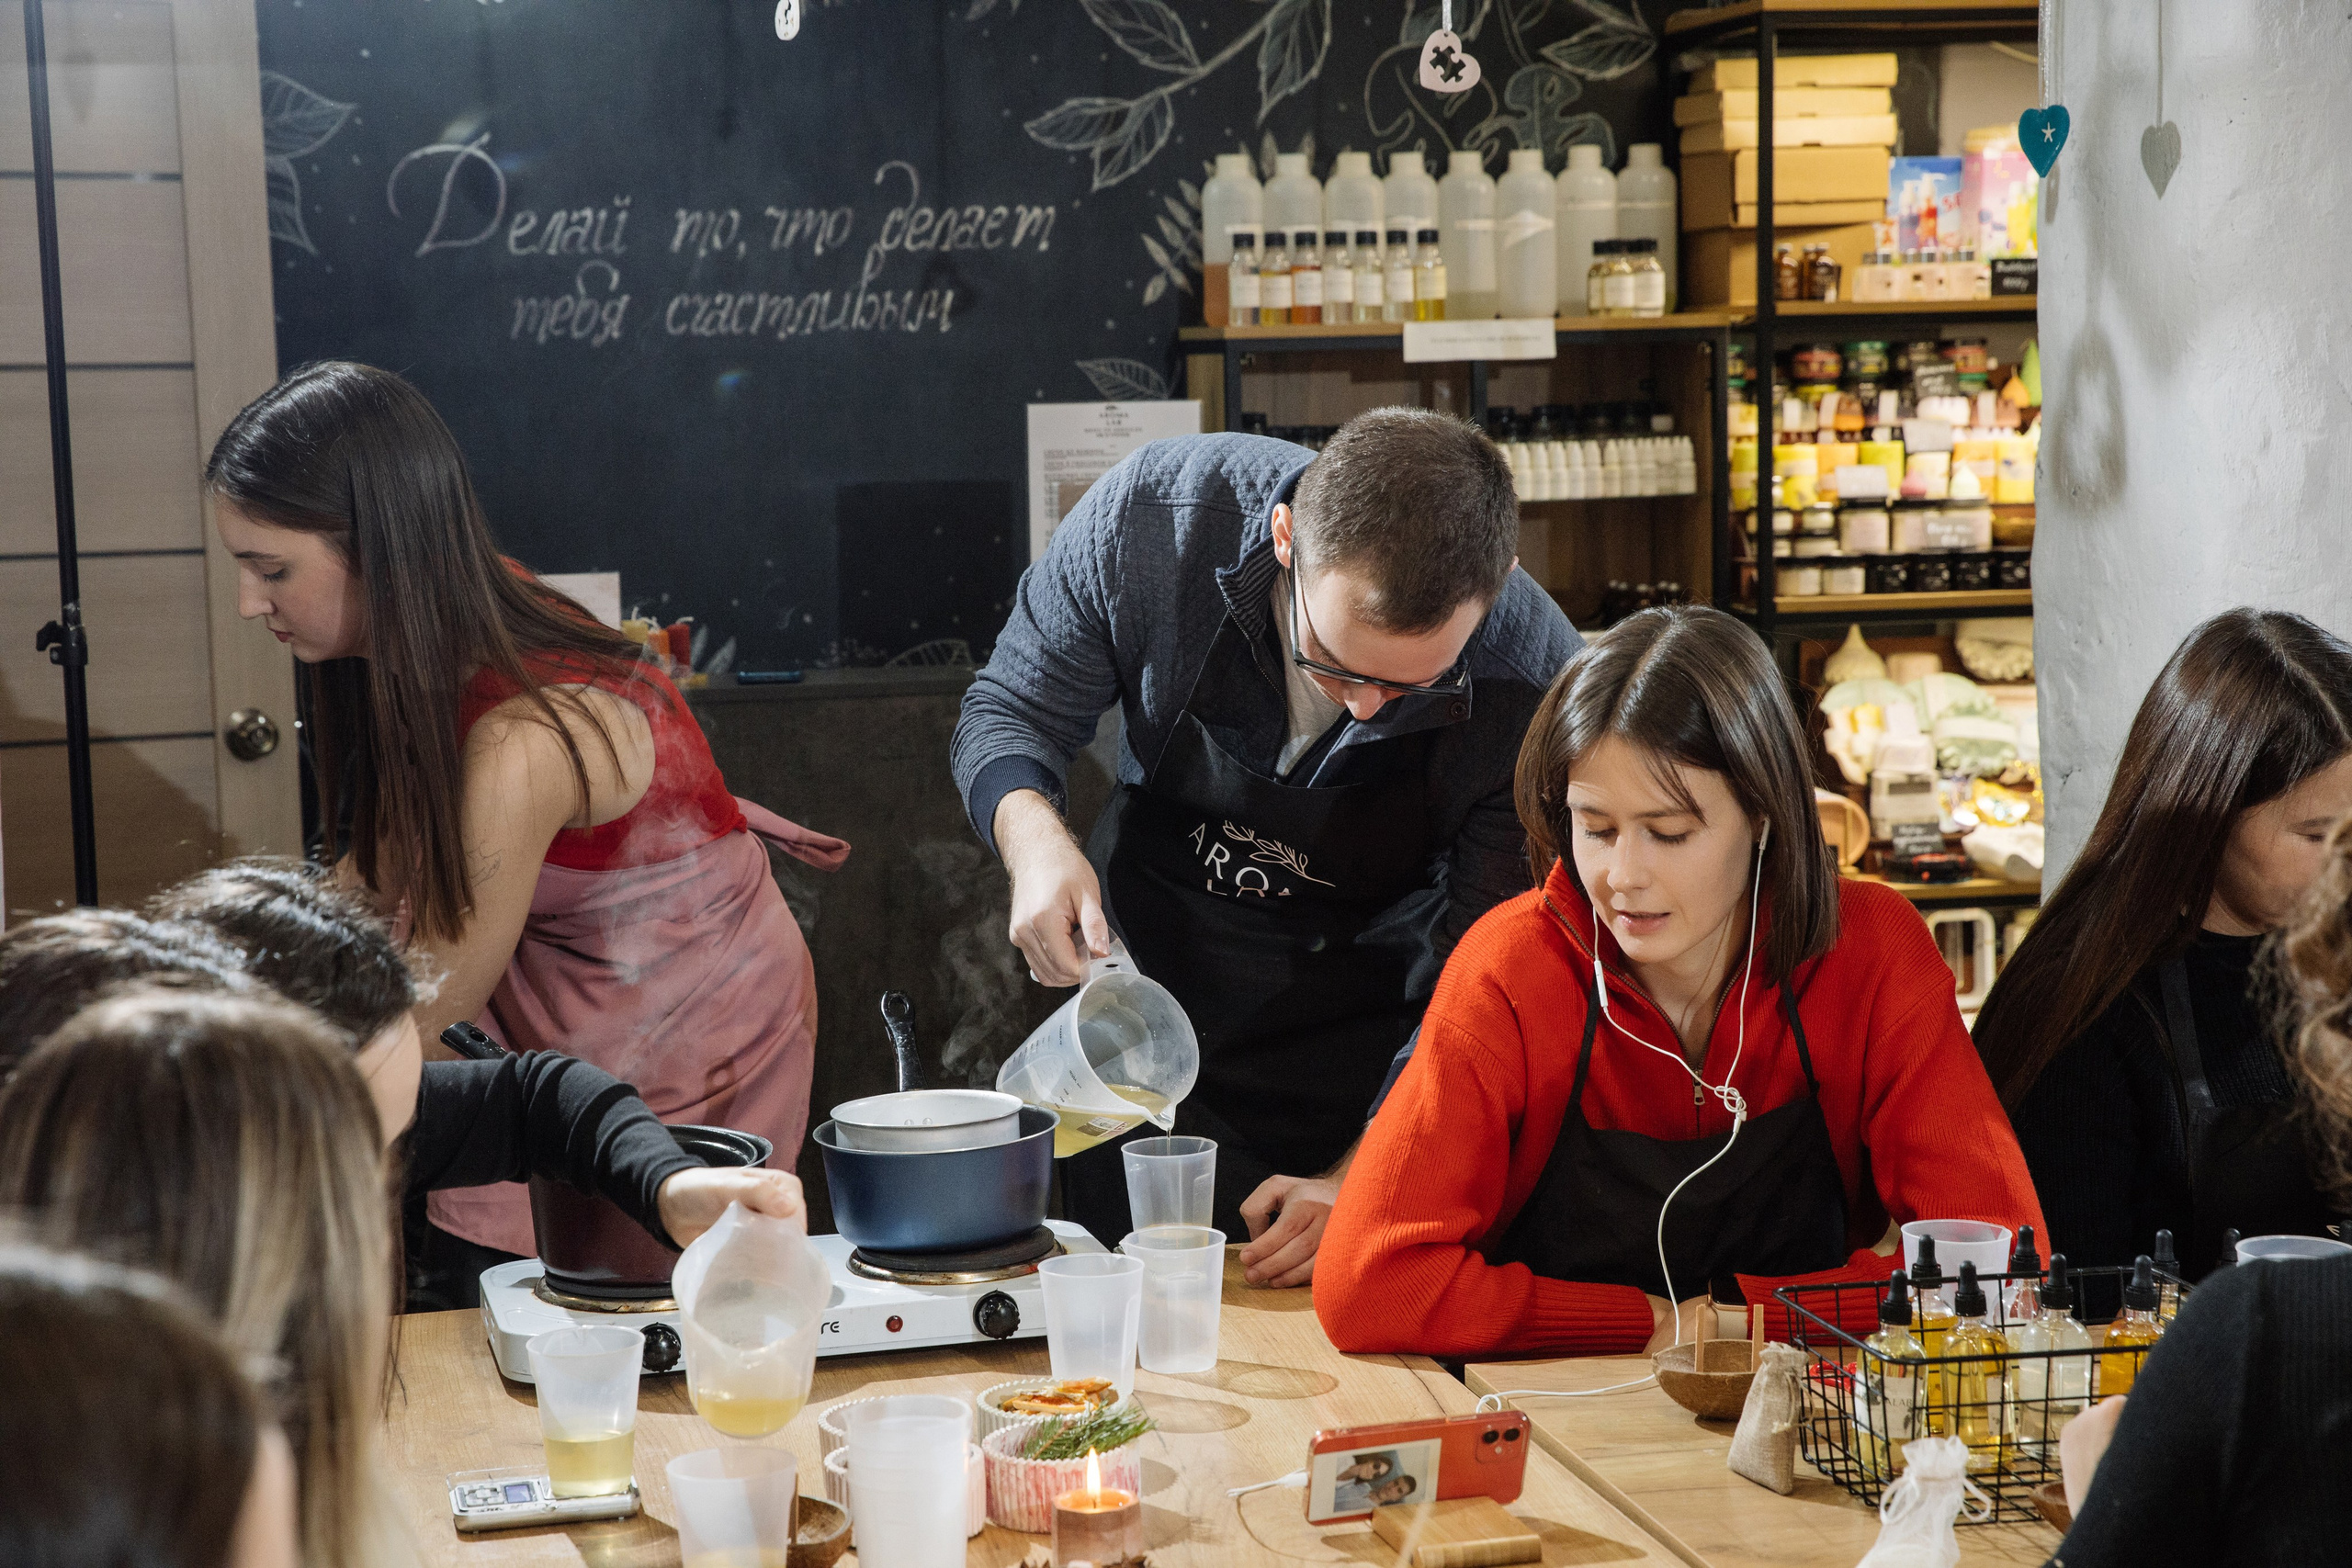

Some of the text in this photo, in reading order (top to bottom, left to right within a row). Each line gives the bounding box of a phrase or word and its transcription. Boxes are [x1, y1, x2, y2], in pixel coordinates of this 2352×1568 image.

[386, 131, 1057, 260] Делай то, что делает
[510, 241, 956, 348] тебя счастливым
